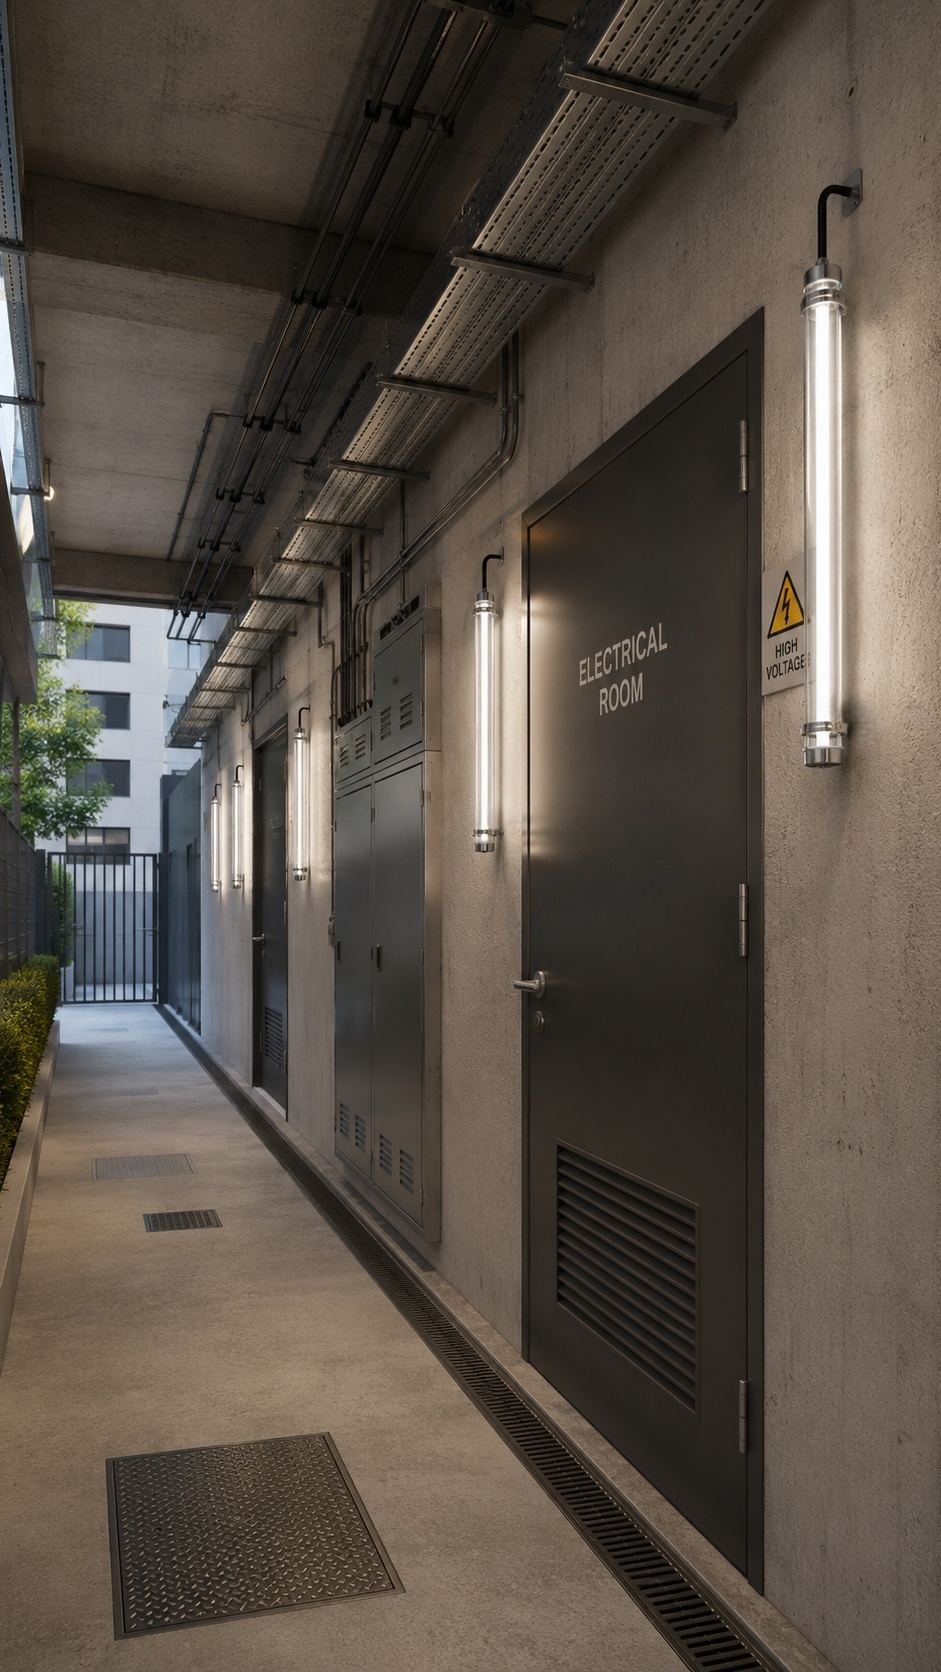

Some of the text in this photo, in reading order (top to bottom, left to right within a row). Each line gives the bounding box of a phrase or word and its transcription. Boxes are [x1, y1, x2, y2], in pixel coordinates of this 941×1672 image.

[578, 622, 668, 686] ELECTRICAL
[775, 637, 798, 659] HIGH
[766, 653, 805, 681] VOLTAGE
[599, 672, 644, 716] ROOM
